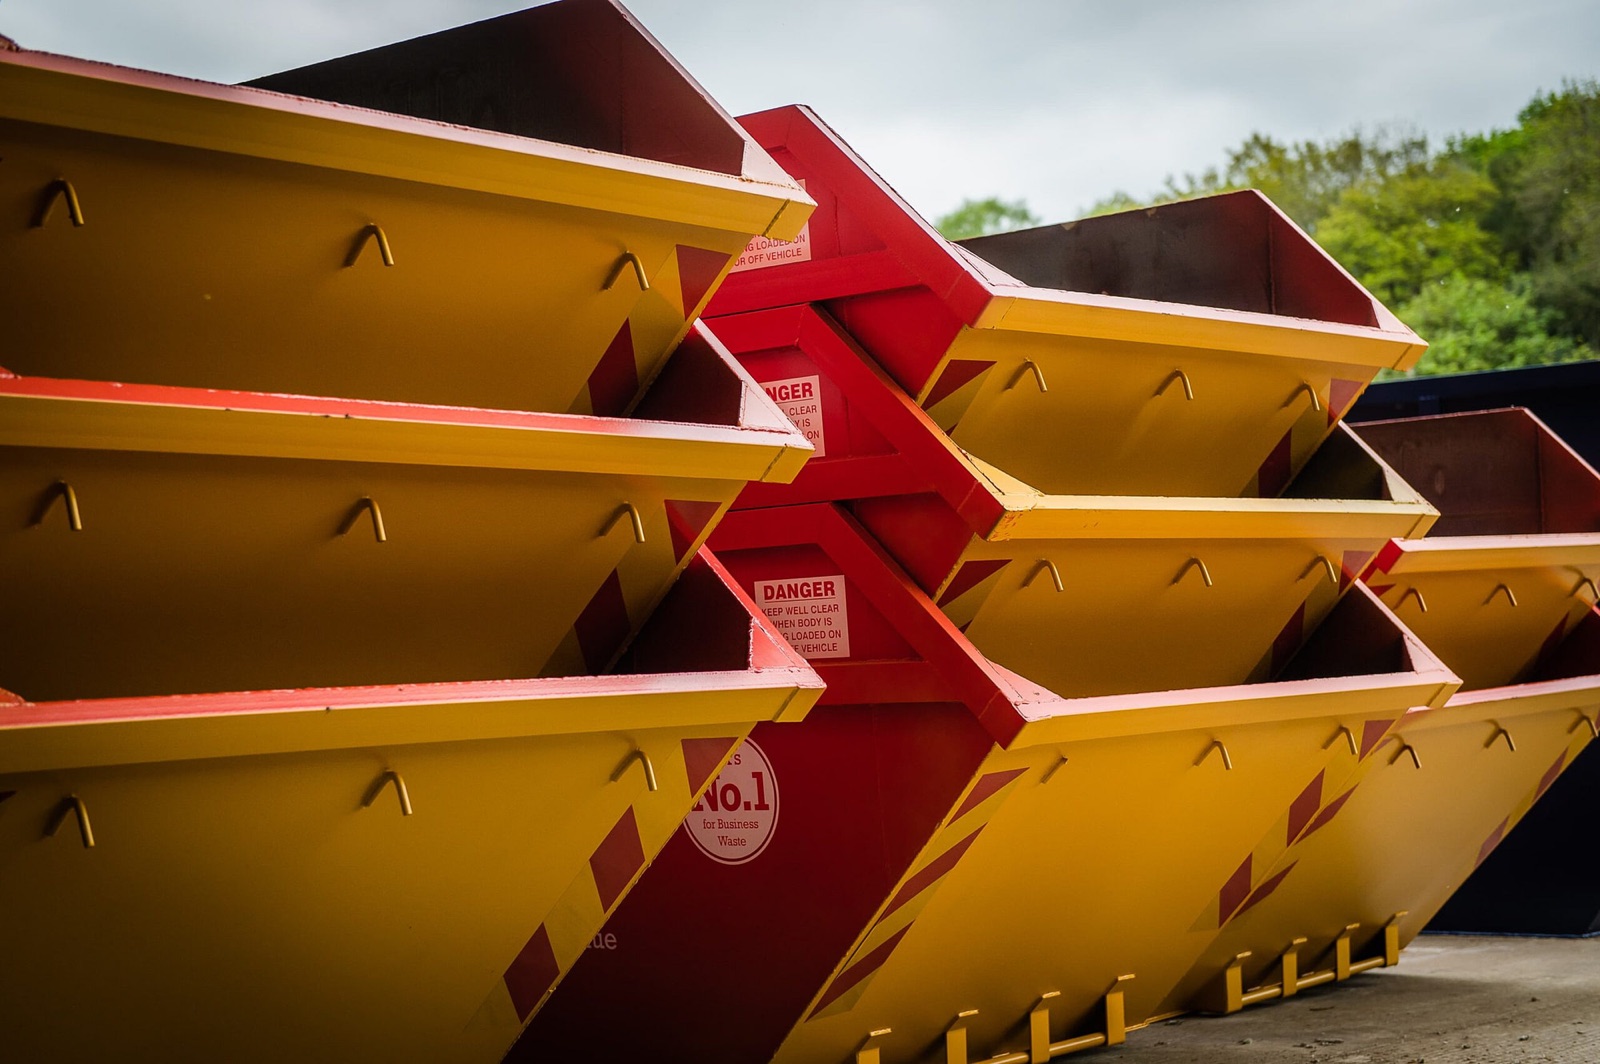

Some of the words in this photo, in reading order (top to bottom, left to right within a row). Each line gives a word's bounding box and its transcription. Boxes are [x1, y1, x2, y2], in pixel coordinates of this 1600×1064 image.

[748, 254, 764, 264] OFF
[766, 247, 802, 260] VEHICLE
[765, 382, 813, 402] NGER
[789, 405, 817, 416] CLEAR
[802, 418, 811, 427] IS
[806, 430, 820, 439] ON
[763, 581, 835, 600] DANGER
[762, 607, 783, 617] KEEP
[785, 606, 809, 615] WELL
[810, 604, 839, 613] CLEAR
[798, 618, 822, 627] BODY
[824, 617, 832, 626] IS
[791, 631, 826, 640] LOADED
[828, 630, 841, 639] ON
[801, 643, 837, 653] VEHICLE
[703, 818, 716, 830] for
[717, 818, 759, 830] Business
[717, 835, 747, 847] Waste
